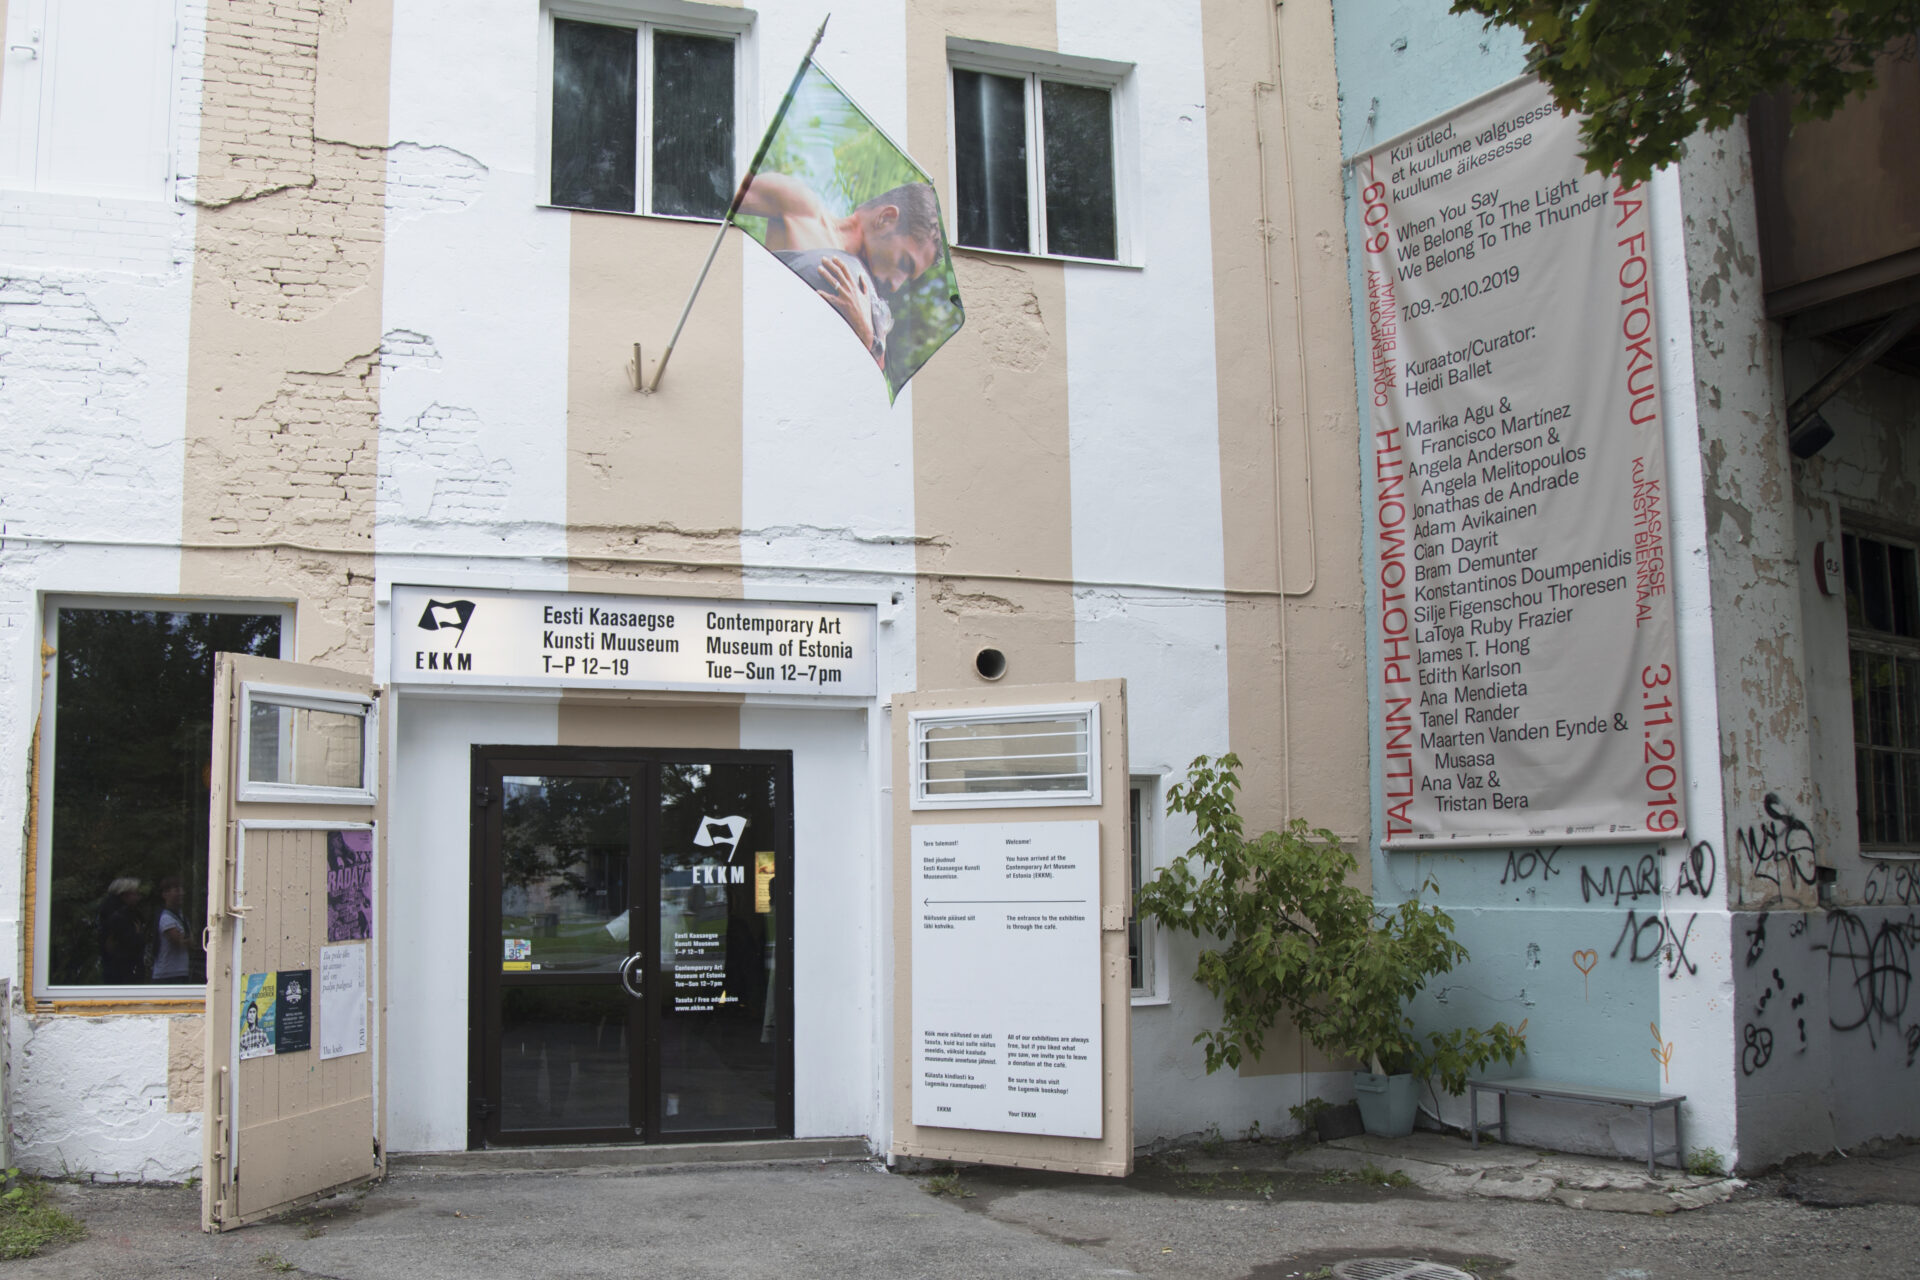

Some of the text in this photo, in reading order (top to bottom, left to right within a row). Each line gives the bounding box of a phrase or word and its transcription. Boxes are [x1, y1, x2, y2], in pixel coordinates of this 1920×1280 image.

[1391, 123, 1456, 164] Kui ütled,
[1392, 168, 1405, 184] et
[1410, 140, 1471, 176] kuulume
[1393, 134, 1532, 204] kuulume äikesesse
[1396, 189, 1499, 242] When You Say
[1398, 178, 1579, 261] We Belong To The Light
[1398, 192, 1608, 281] We Belong To The Thunder
[1368, 270, 1388, 407] CONTEMPORARY
[1380, 277, 1398, 388] ART BIENNIAL
[1617, 231, 1656, 426] FOTOKUU
[1406, 326, 1535, 377] Kuraator/Curator:
[1406, 360, 1492, 397] Heidi Ballet
[1406, 397, 1512, 437] Marika Agu &
[1422, 405, 1571, 454] Francisco Martínez
[1409, 427, 1560, 478] Angela Anderson &
[1421, 447, 1586, 496] Angela Melitopoulos
[1412, 469, 1578, 520] Jonathas de Andrade
[1414, 504, 1536, 540] Adam Avikainen
[1645, 479, 1666, 595] KAASAEGSE
[1414, 532, 1498, 560] Cian Dayrit
[1631, 457, 1652, 629] KUNSTI BIENNAAL
[1416, 548, 1538, 581] Bram Demunter
[1416, 550, 1632, 602] Konstantinos Doumpenidis
[543, 605, 675, 631] Eesti Kaasaegse
[1414, 576, 1626, 624] Silje Figenschou Thoresen
[543, 630, 680, 653] Kunsti Muuseum
[706, 611, 842, 637] Contemporary Art
[1376, 427, 1414, 842] TALLINN PHOTOMONTH
[1416, 609, 1573, 644] LaToya Ruby Frazier
[416, 651, 472, 671] EKKM
[706, 636, 854, 660] Museum of Estonia
[1417, 637, 1530, 665] James T. Hong
[1418, 661, 1520, 686] Edith Karlson
[1420, 682, 1527, 707] Ana Mendieta
[1420, 704, 1520, 727] Tanel Rander
[1421, 712, 1628, 749] Maarten Vanden Eynde &
[1436, 752, 1494, 769] Musasa
[1641, 663, 1679, 833] 3.11.2019
[1421, 770, 1500, 791] Ana Vaz &
[1434, 793, 1528, 812] Tristan Bera
[692, 866, 745, 884] EKKM
